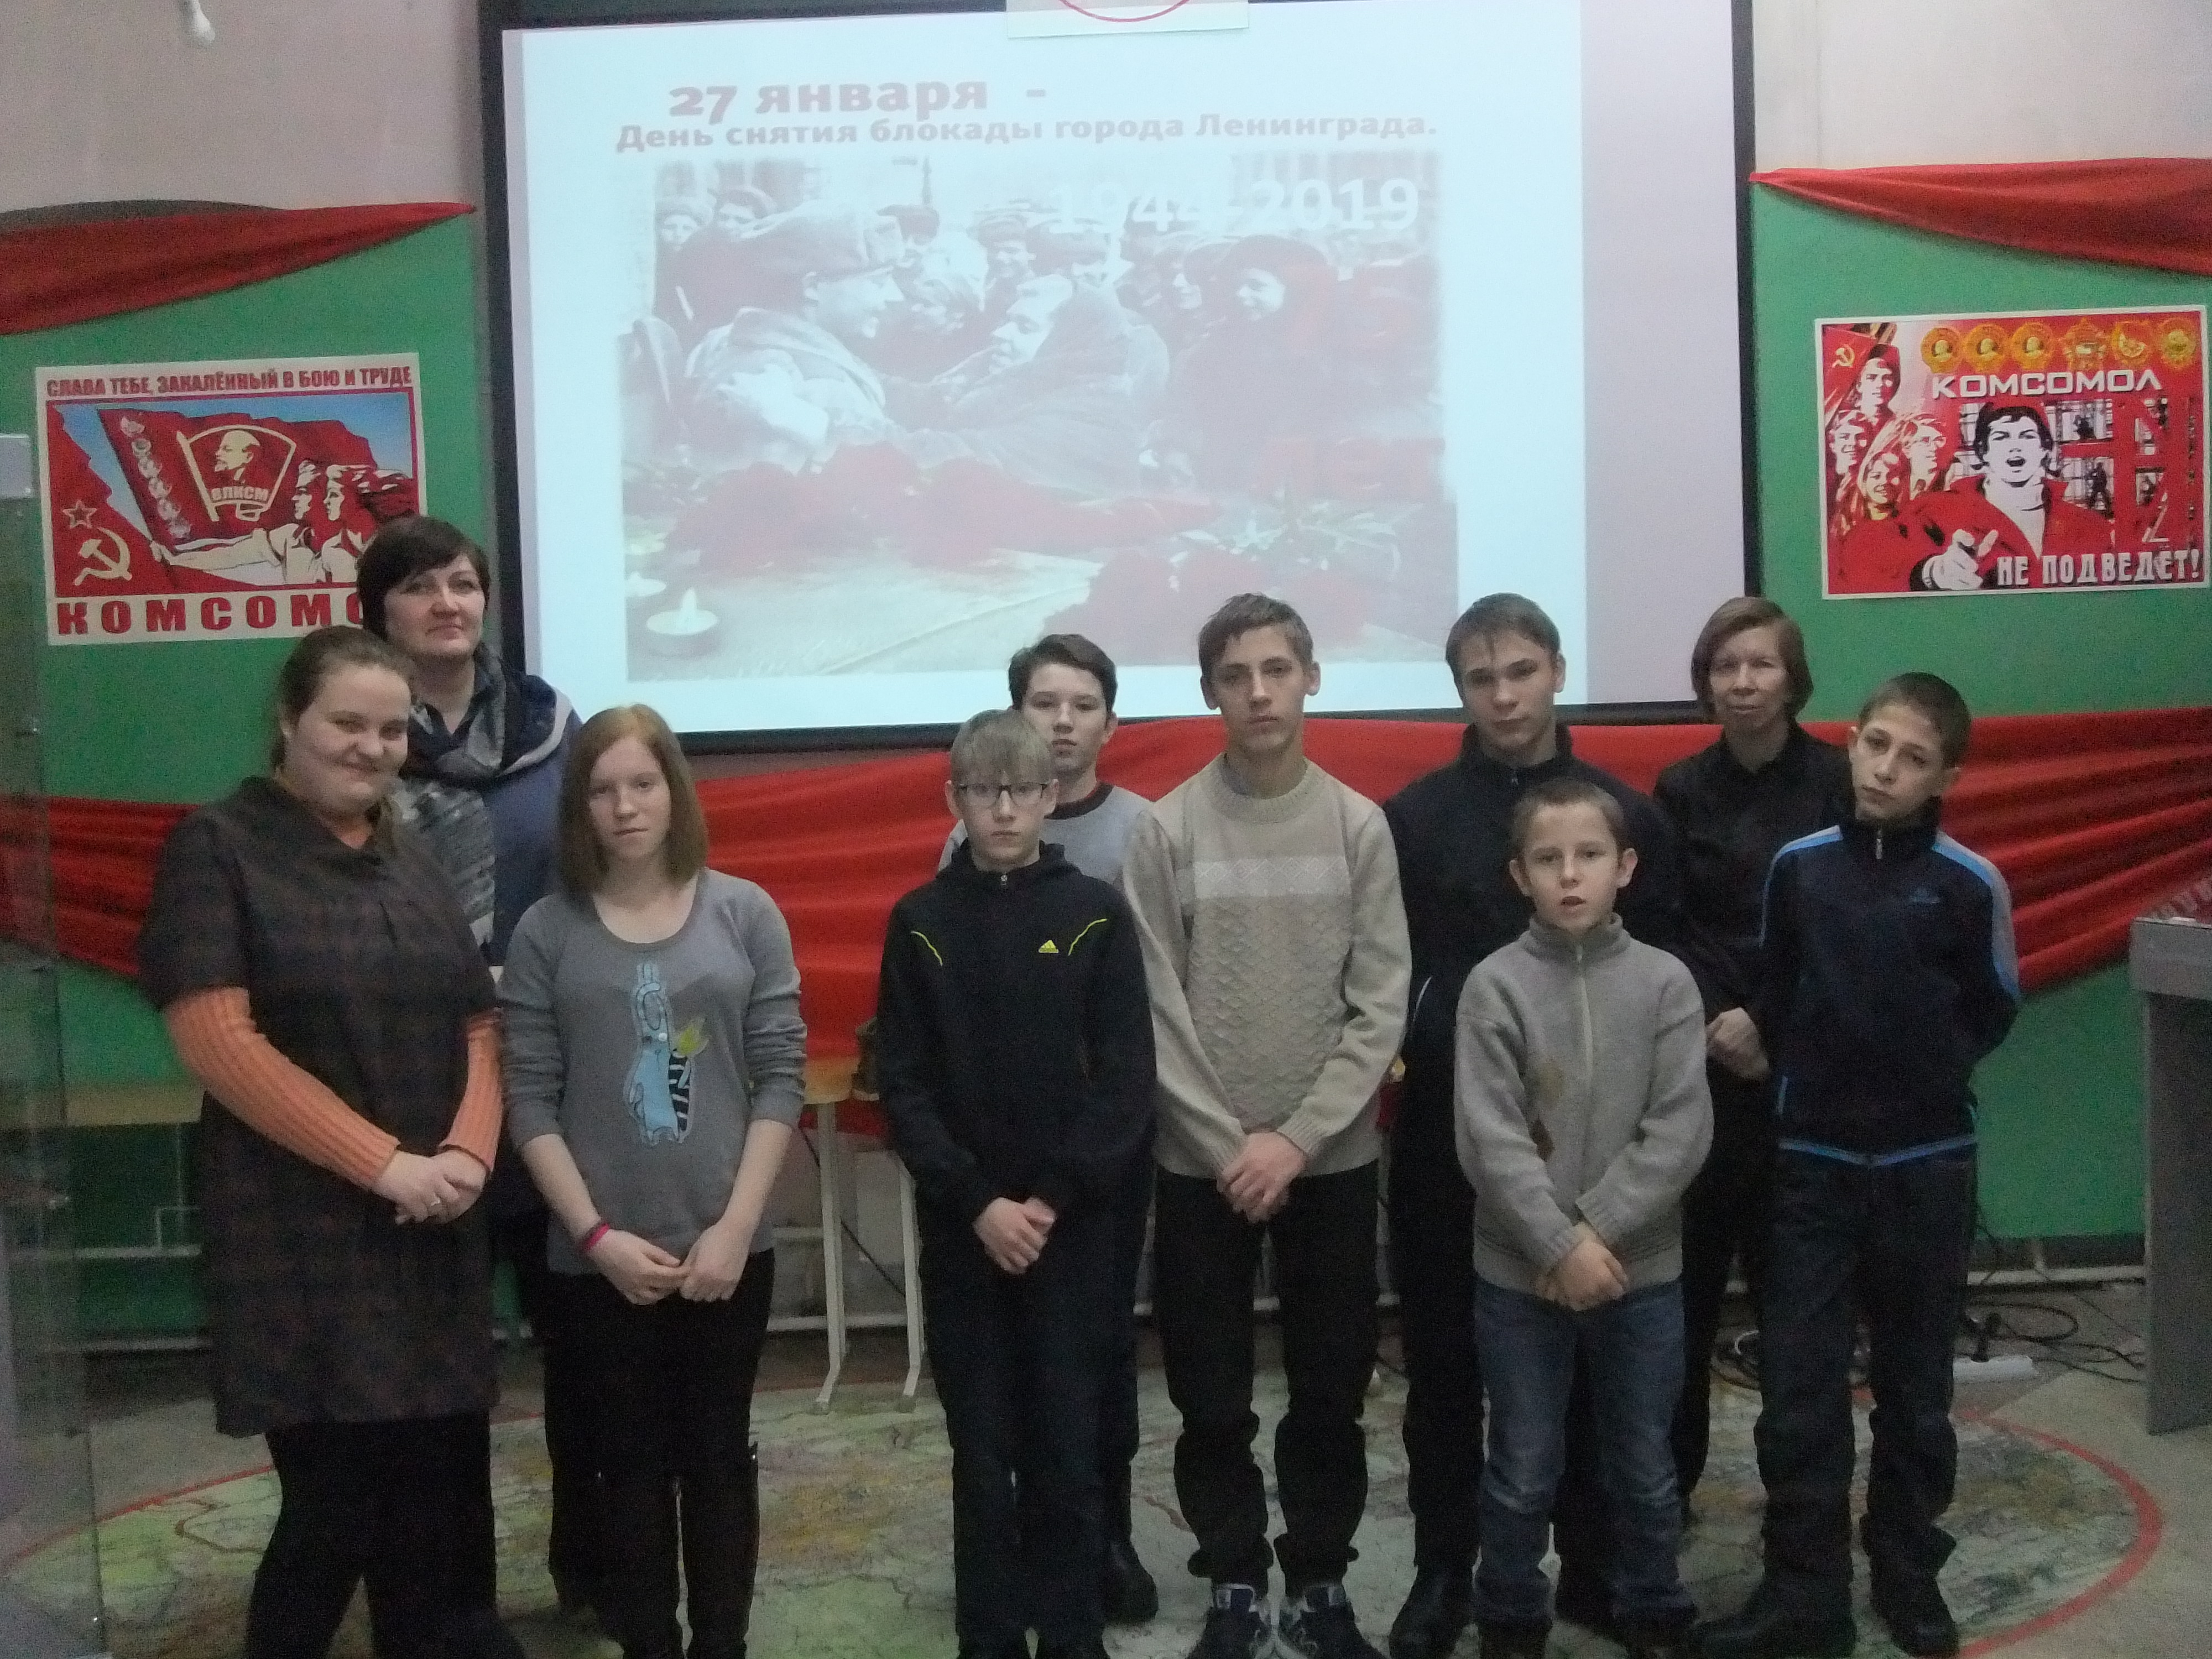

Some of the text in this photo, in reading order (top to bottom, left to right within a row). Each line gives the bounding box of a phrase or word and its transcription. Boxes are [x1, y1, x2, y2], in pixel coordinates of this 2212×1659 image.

[669, 85, 738, 125] 27
[754, 81, 988, 121] января
[615, 113, 1438, 153] День снятия блокады города Ленинграда.
[46, 378, 106, 397] СЛАВА
[283, 370, 295, 388] В
[299, 369, 341, 388] БОЮ
[345, 368, 356, 386] И
[359, 366, 412, 388] ТРУДЕ
[1931, 369, 2162, 399] КОМСОМОЛ
[1997, 555, 2030, 586] НЕ
[56, 592, 363, 635] КОМСОМО
